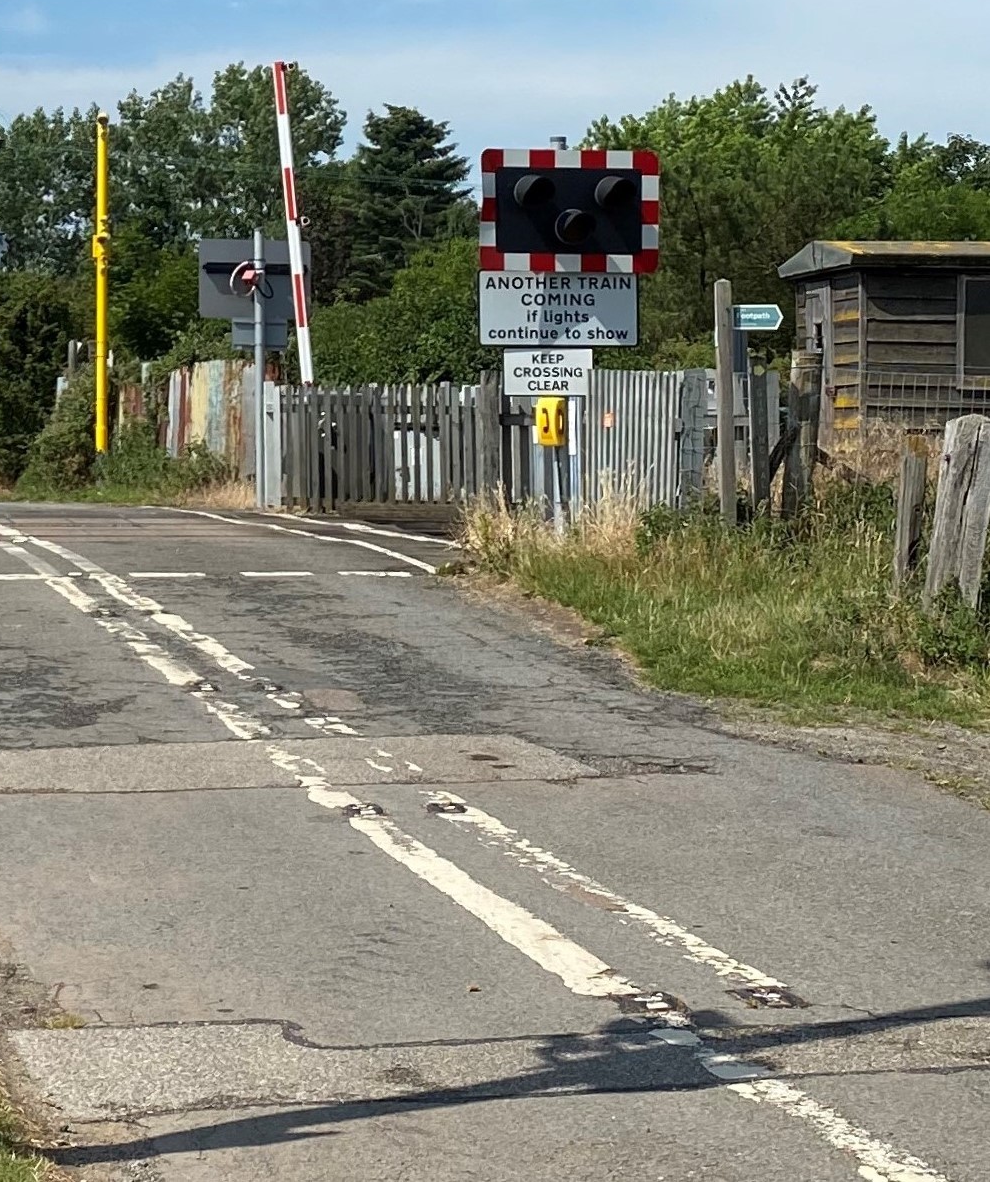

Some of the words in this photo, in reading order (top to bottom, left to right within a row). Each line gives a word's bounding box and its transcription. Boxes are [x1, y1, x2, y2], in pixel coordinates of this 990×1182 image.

[485, 276, 571, 290] ANOTHER
[578, 276, 631, 290] TRAIN
[521, 293, 595, 306] COMING
[526, 309, 538, 322] if
[543, 309, 590, 325] lights
[488, 327, 559, 339] continue
[565, 327, 581, 339] to
[587, 327, 628, 339] show
[531, 354, 565, 364] KEEP
[513, 367, 583, 378] CROSSING
[527, 380, 569, 391] CLEAR
